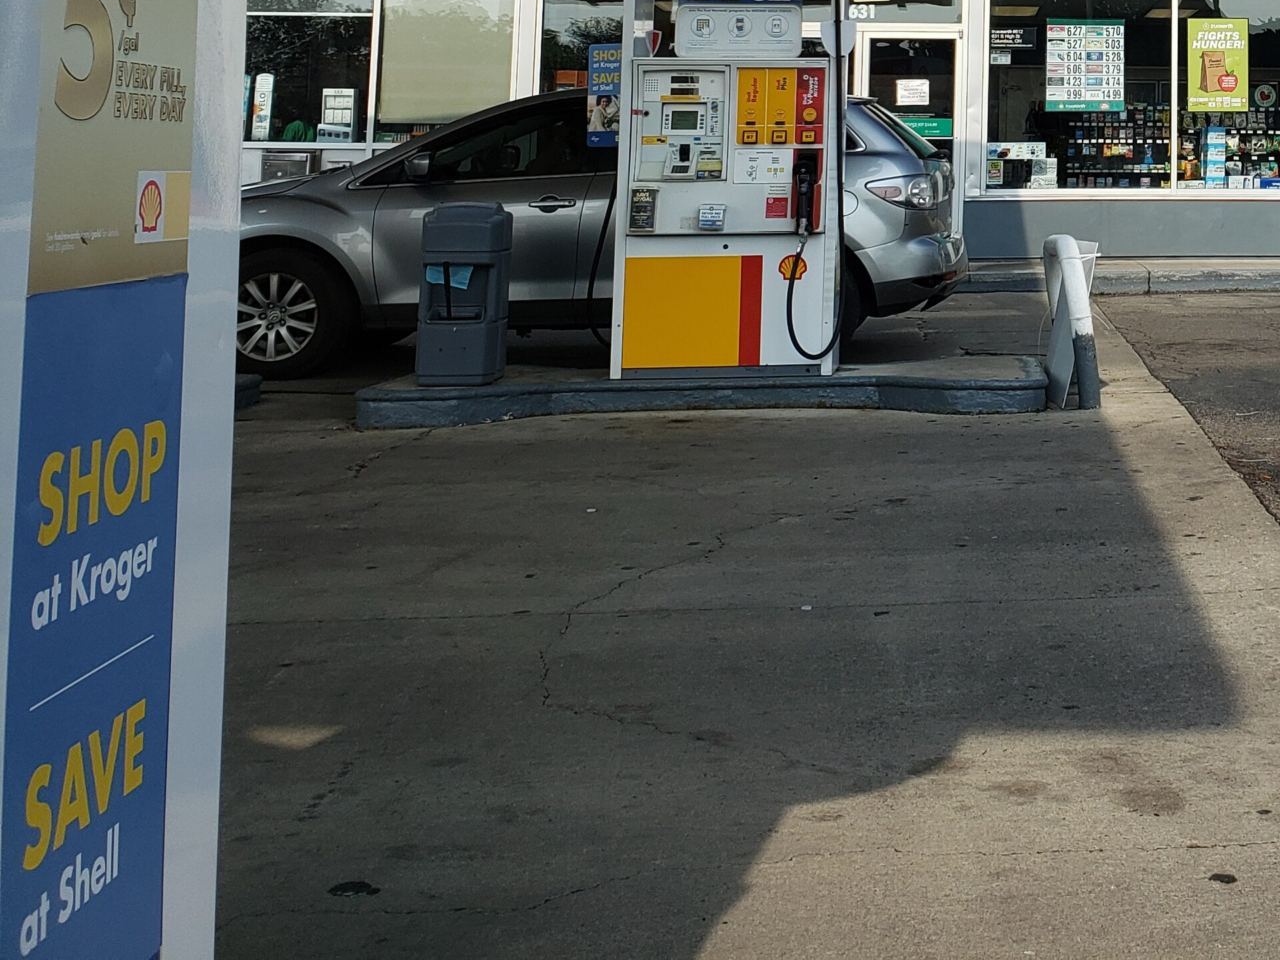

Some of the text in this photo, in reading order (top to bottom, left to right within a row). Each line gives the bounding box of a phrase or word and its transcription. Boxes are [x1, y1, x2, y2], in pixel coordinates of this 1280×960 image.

[849, 5, 876, 19] 631
[1192, 40, 1245, 49] HUNGER!
[1197, 31, 1240, 40] FIGHTS
[115, 60, 157, 90] EVERY
[592, 72, 619, 84] SAVE
[258, 92, 266, 113] VELO
[751, 77, 759, 103] Regular
[114, 91, 186, 122] EVERY DAY
[37, 420, 166, 547] SHOP
[30, 536, 158, 631] at Kroger
[22, 697, 147, 872] SAVE
[19, 822, 120, 957] at Shell
